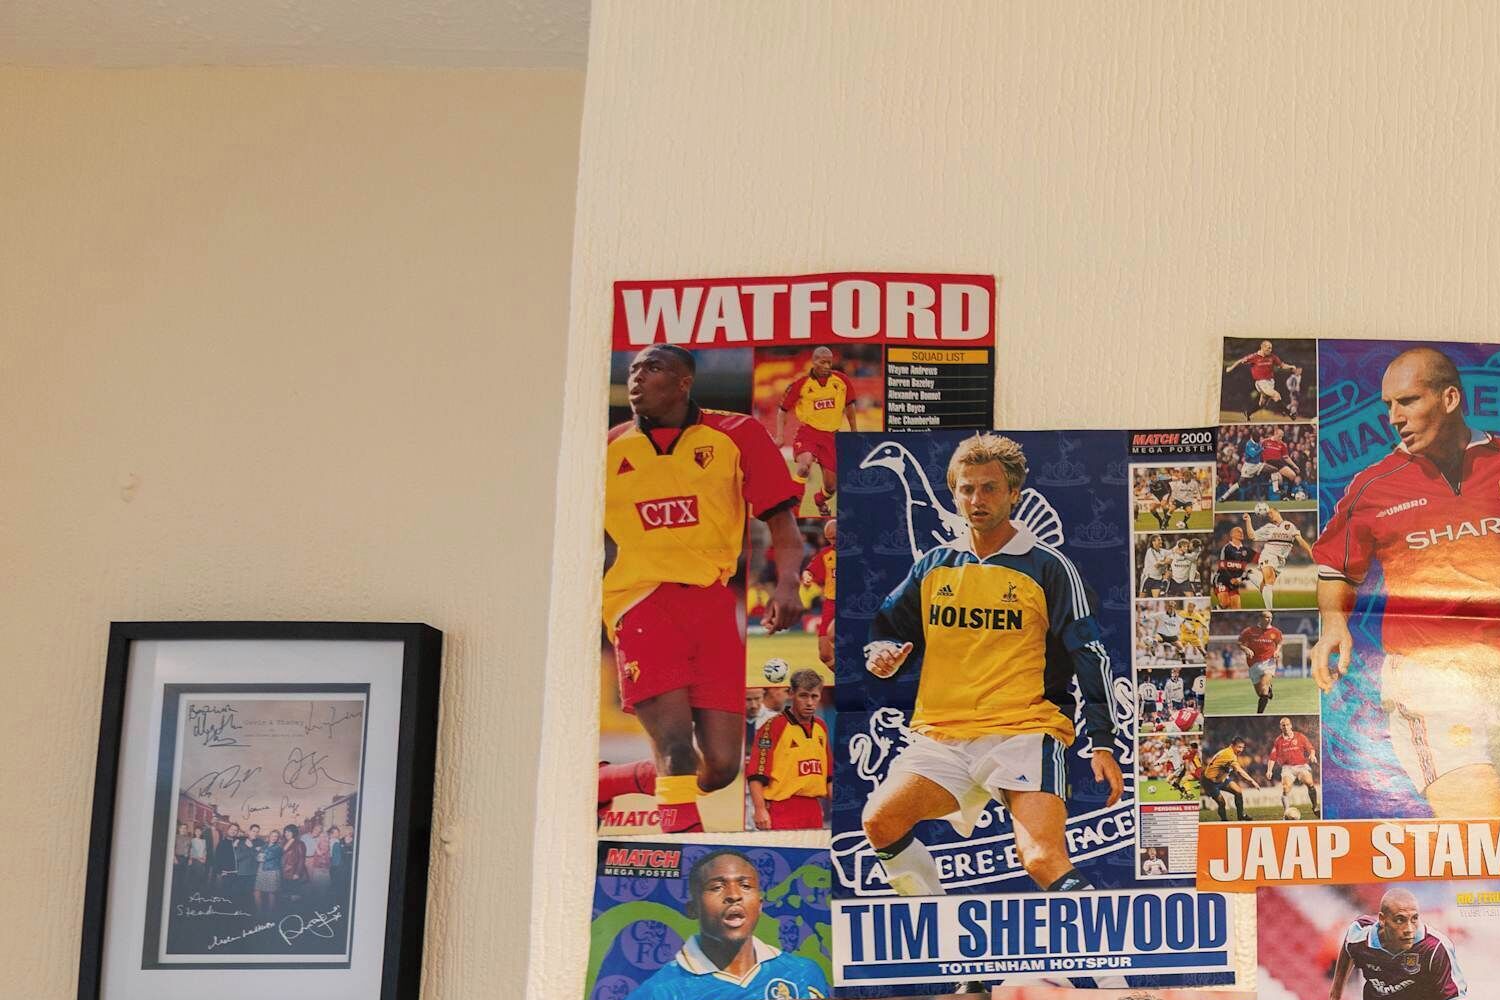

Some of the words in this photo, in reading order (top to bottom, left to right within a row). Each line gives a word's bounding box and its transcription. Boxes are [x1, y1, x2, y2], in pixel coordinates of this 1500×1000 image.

[621, 280, 990, 345] WATFORD
[911, 351, 943, 361] SQUAD
[946, 352, 966, 361] LIST
[888, 365, 909, 376] Wayne
[888, 403, 906, 413] Mark
[907, 403, 926, 414] Boyce
[1132, 433, 1179, 445] MATCH
[1181, 432, 1212, 444] 2000
[635, 498, 698, 528] CTX
[1384, 497, 1427, 517] UMBRO
[929, 605, 1022, 630] HOLSTEN
[603, 809, 677, 826] MATCH
[607, 848, 680, 868] MATCH
[1209, 826, 1351, 882] JAAP
[638, 869, 680, 878] POSTER
[841, 902, 939, 962] TIM
[958, 893, 1228, 959] SHERWOOD
[938, 959, 1046, 975] TOTTENHAM
[1049, 956, 1132, 971] HOTSPUR
